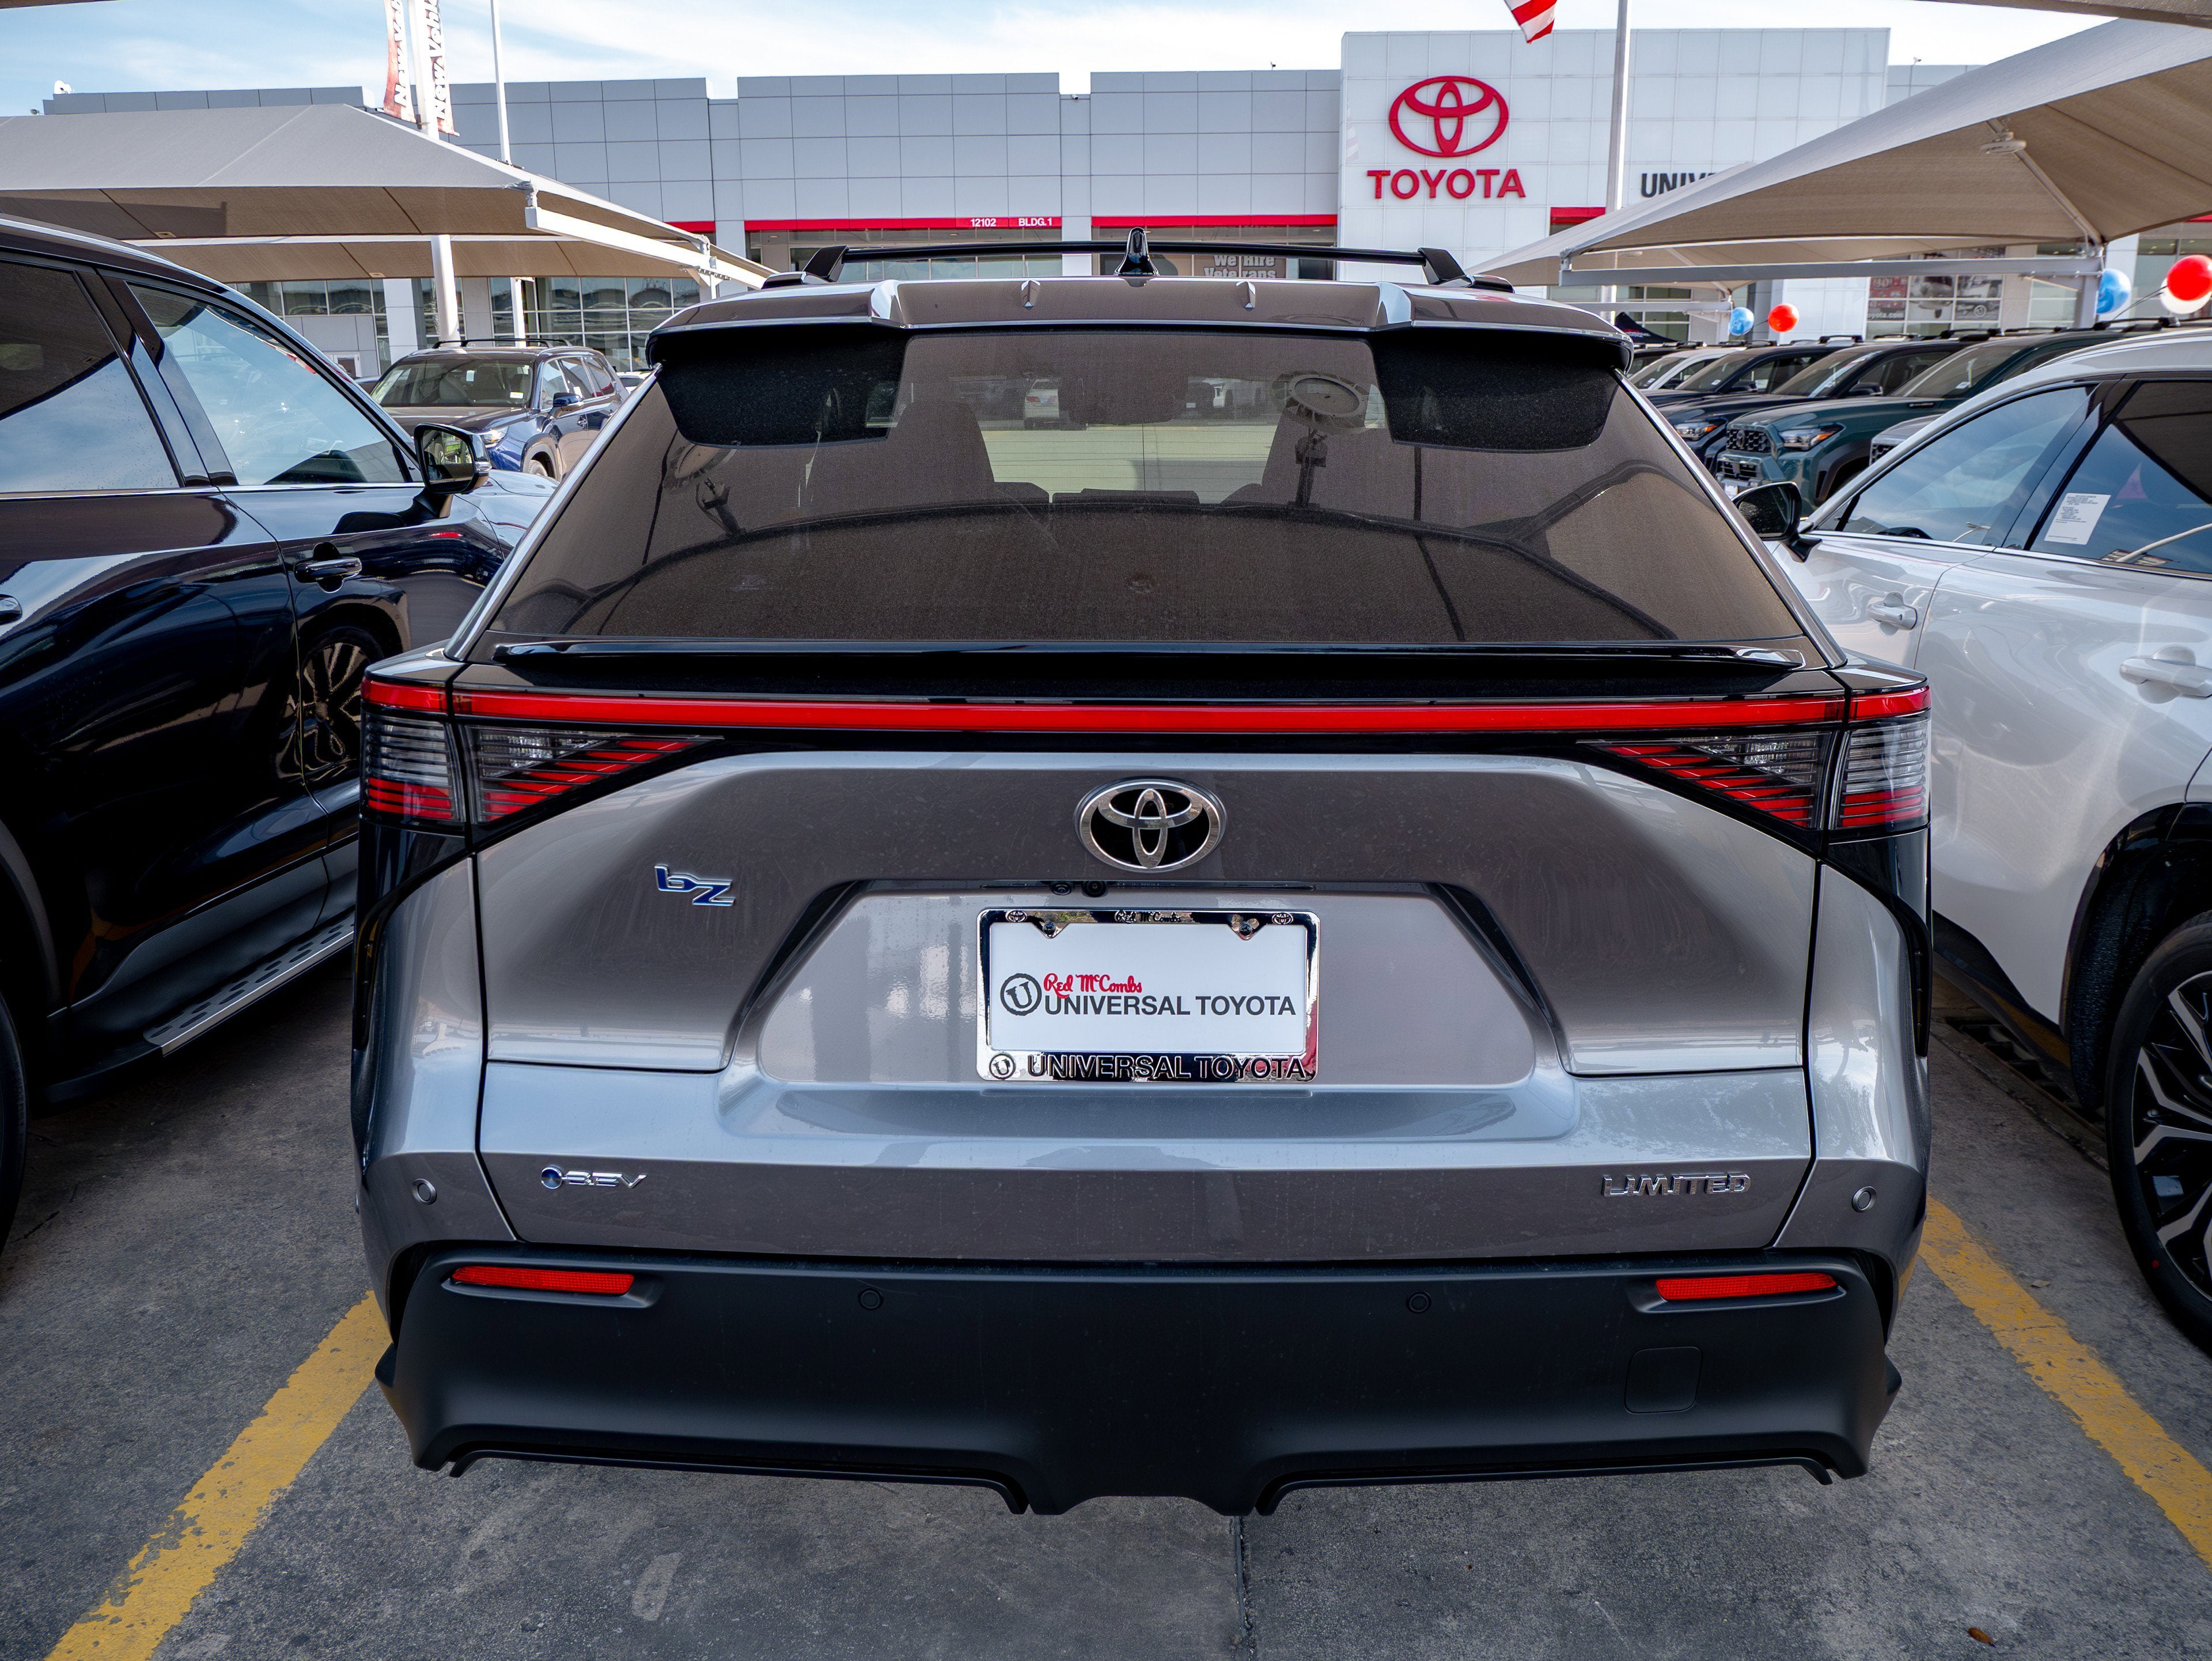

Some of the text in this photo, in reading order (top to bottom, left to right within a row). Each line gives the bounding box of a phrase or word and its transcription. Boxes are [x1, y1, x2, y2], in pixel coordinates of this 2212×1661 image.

[1367, 169, 1526, 199] TOYOTA
[971, 218, 997, 227] 12102
[1214, 255, 1275, 267] We Hire
[1114, 910, 1181, 924] Red McCombs
[1044, 973, 1142, 999] Red McCombs
[1045, 996, 1191, 1015] UNIVERSAL
[1195, 996, 1296, 1015] TOYOTA
[1027, 1055, 1191, 1079] UNIVERSAL
[1194, 1055, 1306, 1079] TOYOTA
[1602, 1174, 1751, 1197] LIMITED
